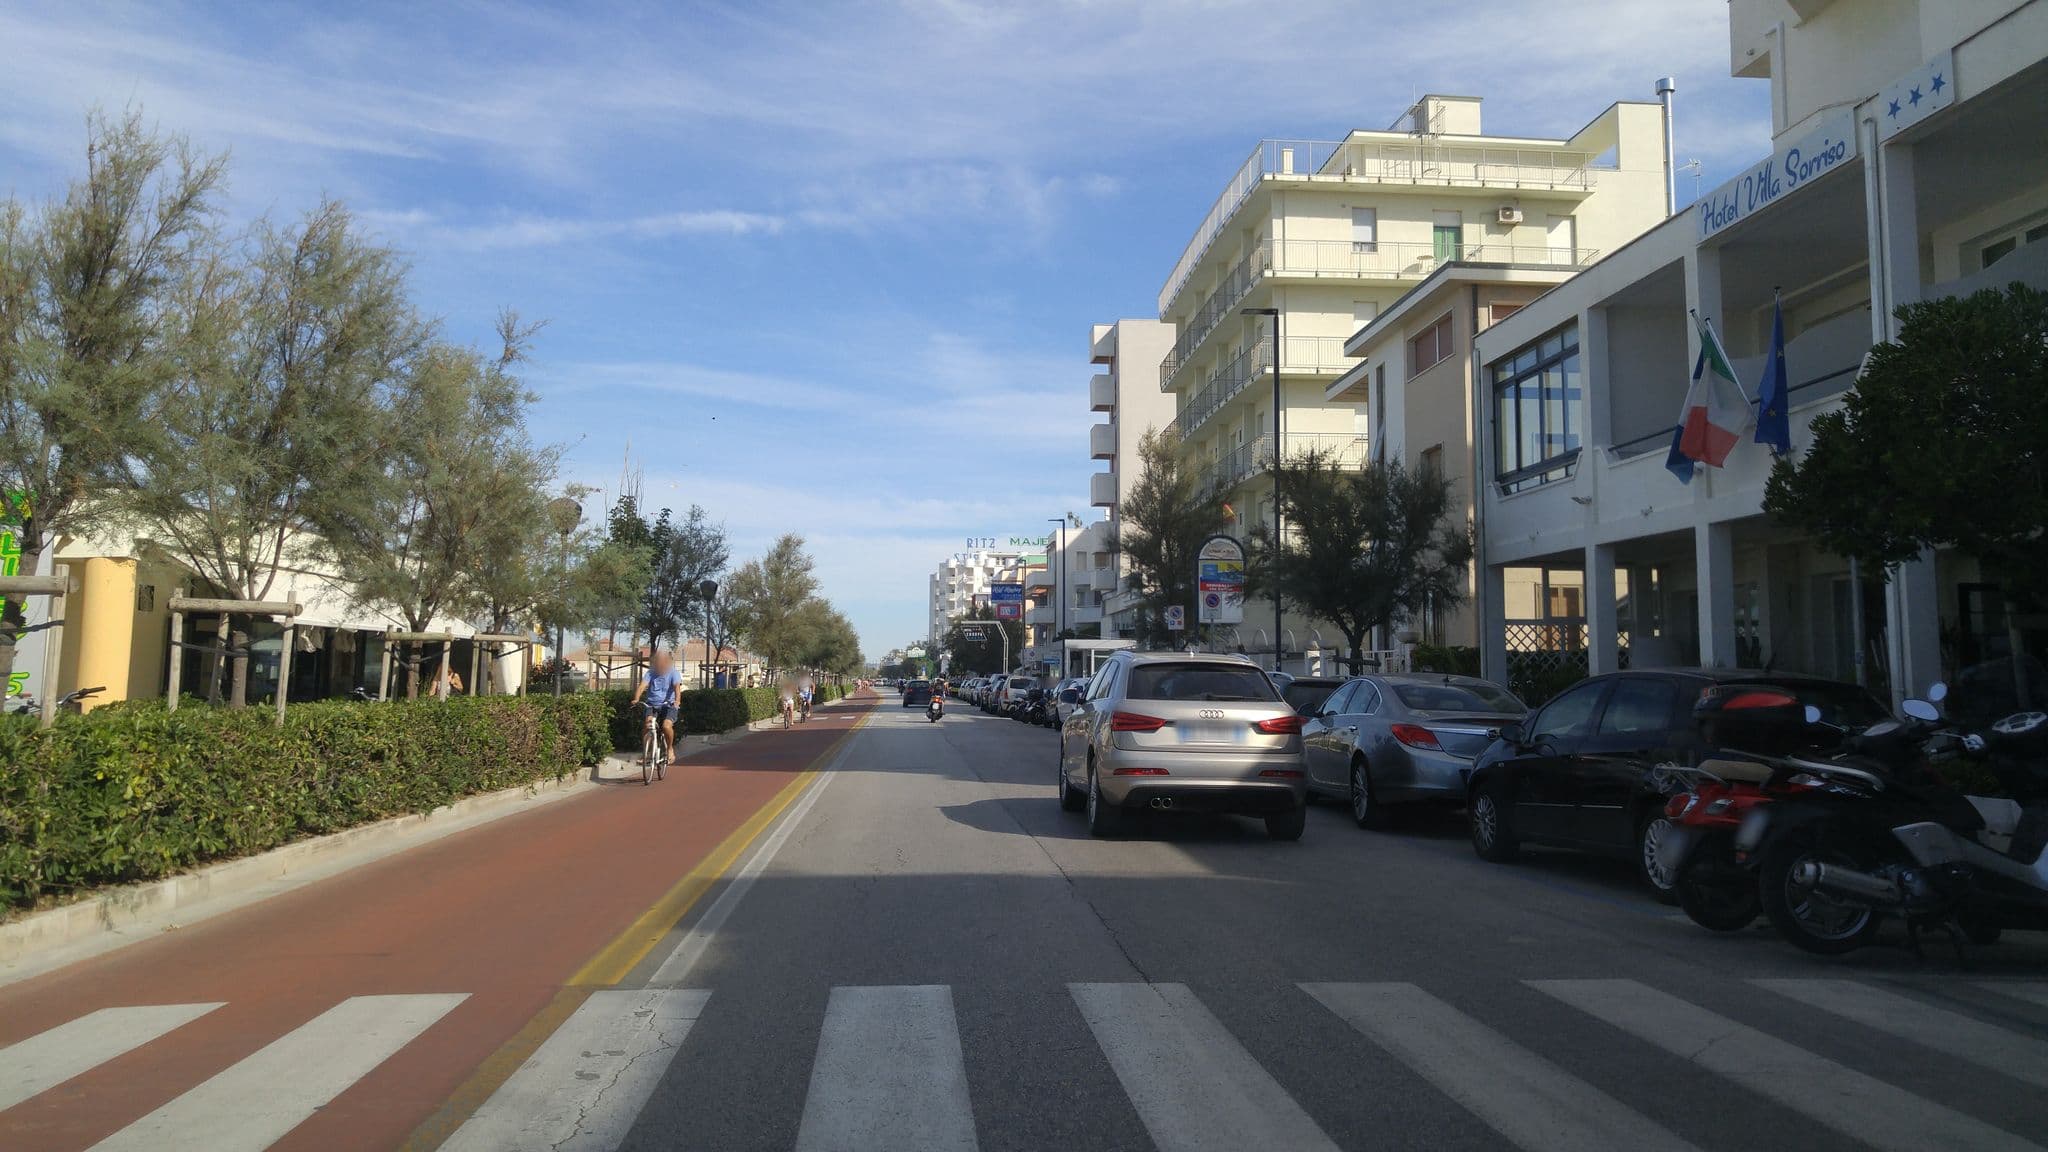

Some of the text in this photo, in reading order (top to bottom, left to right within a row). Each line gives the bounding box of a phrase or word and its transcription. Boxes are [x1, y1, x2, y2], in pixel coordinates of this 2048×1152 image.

[1701, 138, 1846, 235] Hotel Villa Sorriso
[966, 537, 996, 549] RITZ
